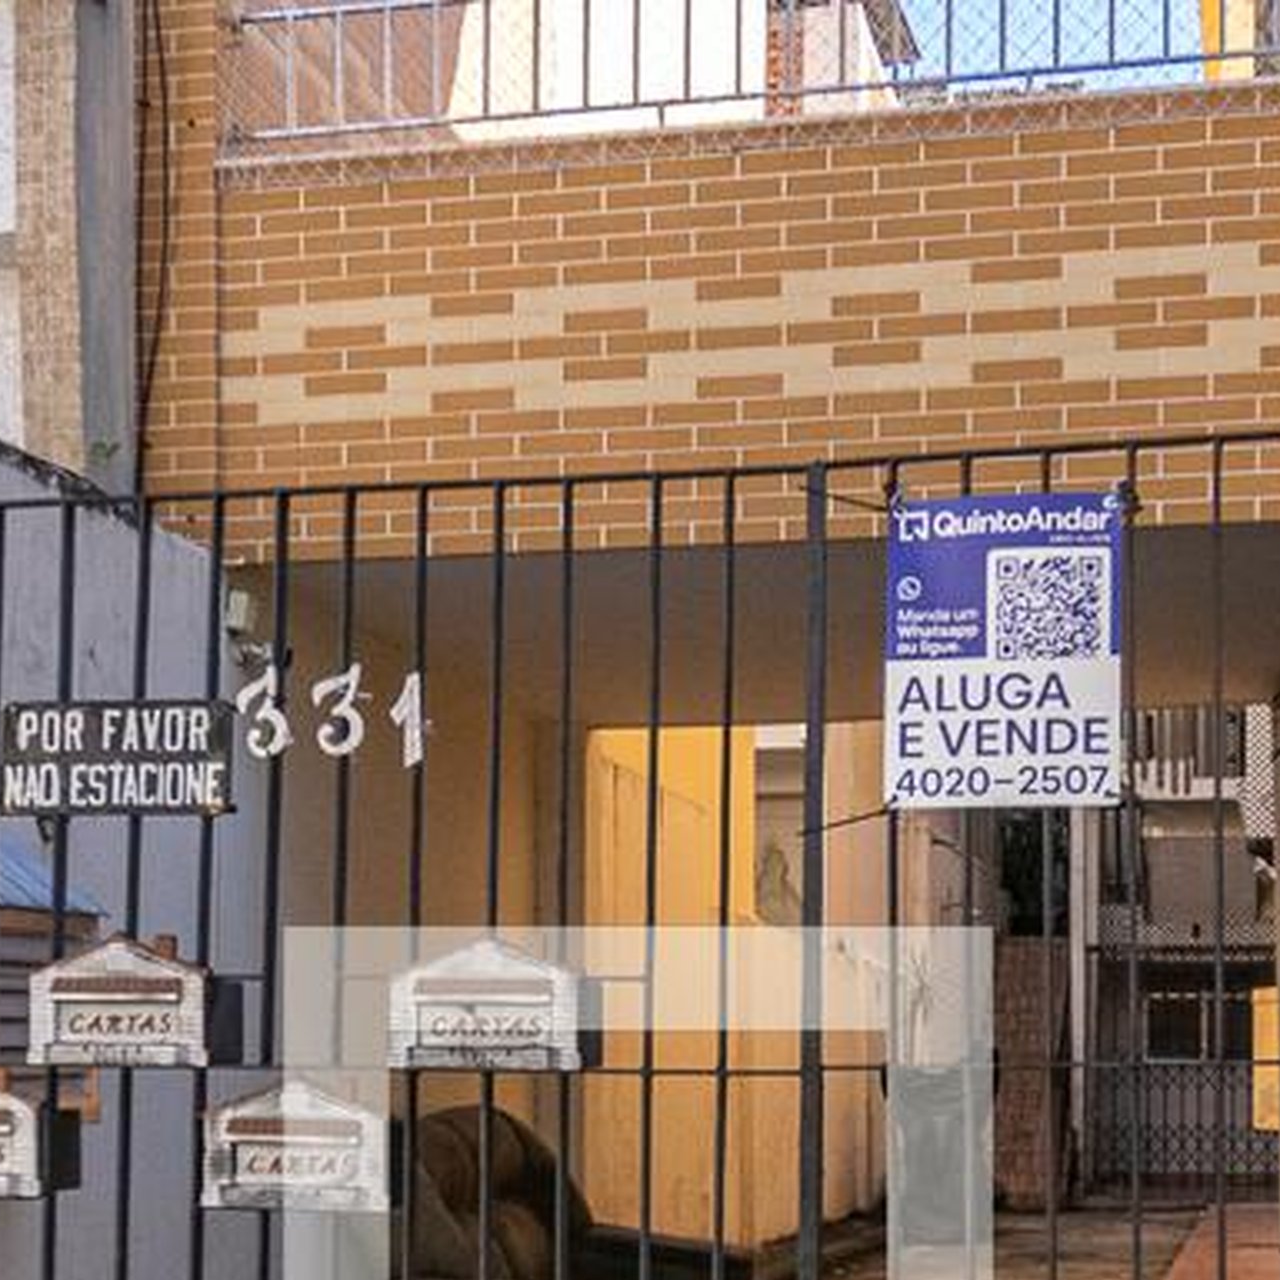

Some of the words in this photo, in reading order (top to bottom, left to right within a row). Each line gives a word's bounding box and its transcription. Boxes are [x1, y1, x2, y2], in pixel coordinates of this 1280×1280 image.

[933, 506, 1112, 538] QuintoAndar
[898, 672, 1071, 714] ALUGA
[19, 708, 83, 752] POR
[102, 707, 211, 752] FAVOR
[236, 662, 422, 768] 331
[898, 721, 924, 758] E
[938, 717, 1111, 757] VENDE
[69, 761, 226, 808] ESTACIONE
[896, 765, 1110, 798] 4020-2507
[69, 1012, 172, 1034] CARTAS
[431, 1012, 543, 1037] CARTAS
